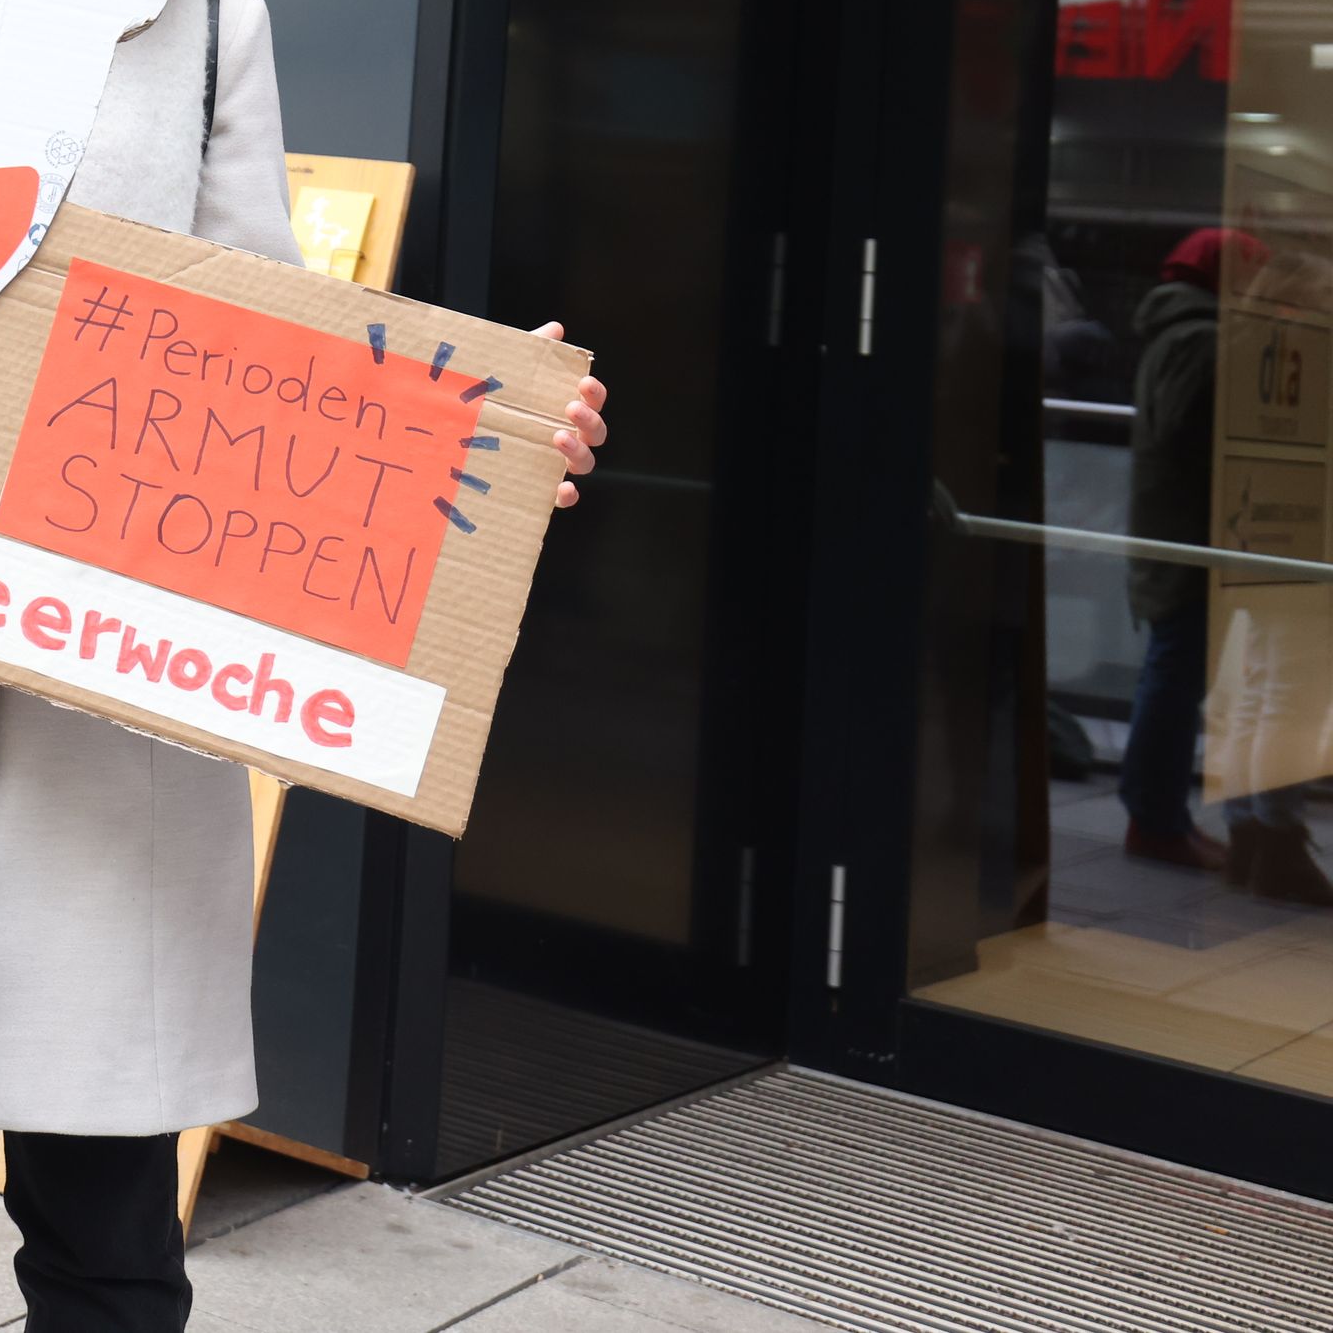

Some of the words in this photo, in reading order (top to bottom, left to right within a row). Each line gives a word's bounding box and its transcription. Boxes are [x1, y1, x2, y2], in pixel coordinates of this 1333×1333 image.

[73, 285, 435, 441] #Perioden-
[47, 377, 414, 528] ARMUT
[45, 454, 417, 625] STOPPEN
